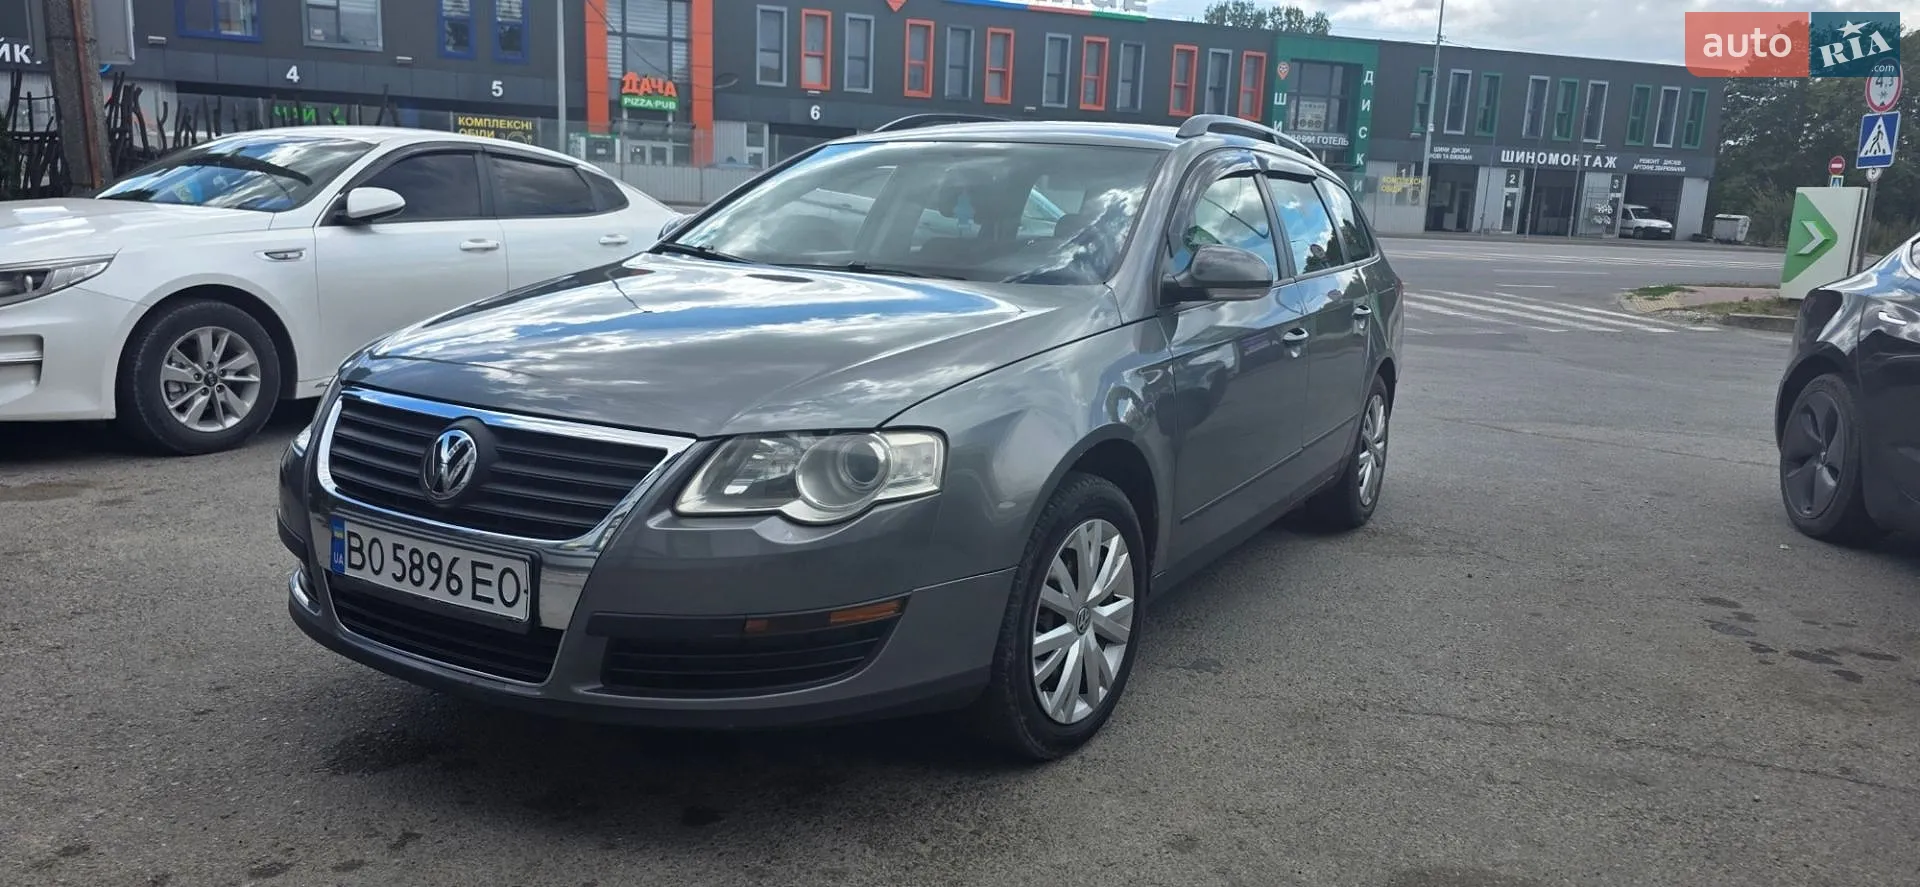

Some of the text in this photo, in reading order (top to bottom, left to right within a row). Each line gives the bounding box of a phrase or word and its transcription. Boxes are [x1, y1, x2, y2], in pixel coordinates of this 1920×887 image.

[286, 65, 300, 83] 4
[491, 80, 504, 97] 5
[622, 72, 677, 97] ДАЧА
[810, 105, 820, 120] 6
[458, 116, 532, 130] КОМПЛЕКСНІ
[1317, 136, 1349, 146] ГОТЕЛЬ
[1501, 150, 1618, 168] ШИНОМОНТАЖ
[1509, 174, 1516, 184] 2
[1613, 179, 1619, 189] 3
[333, 551, 344, 564] UA
[346, 530, 521, 608] BO 5896 EO
